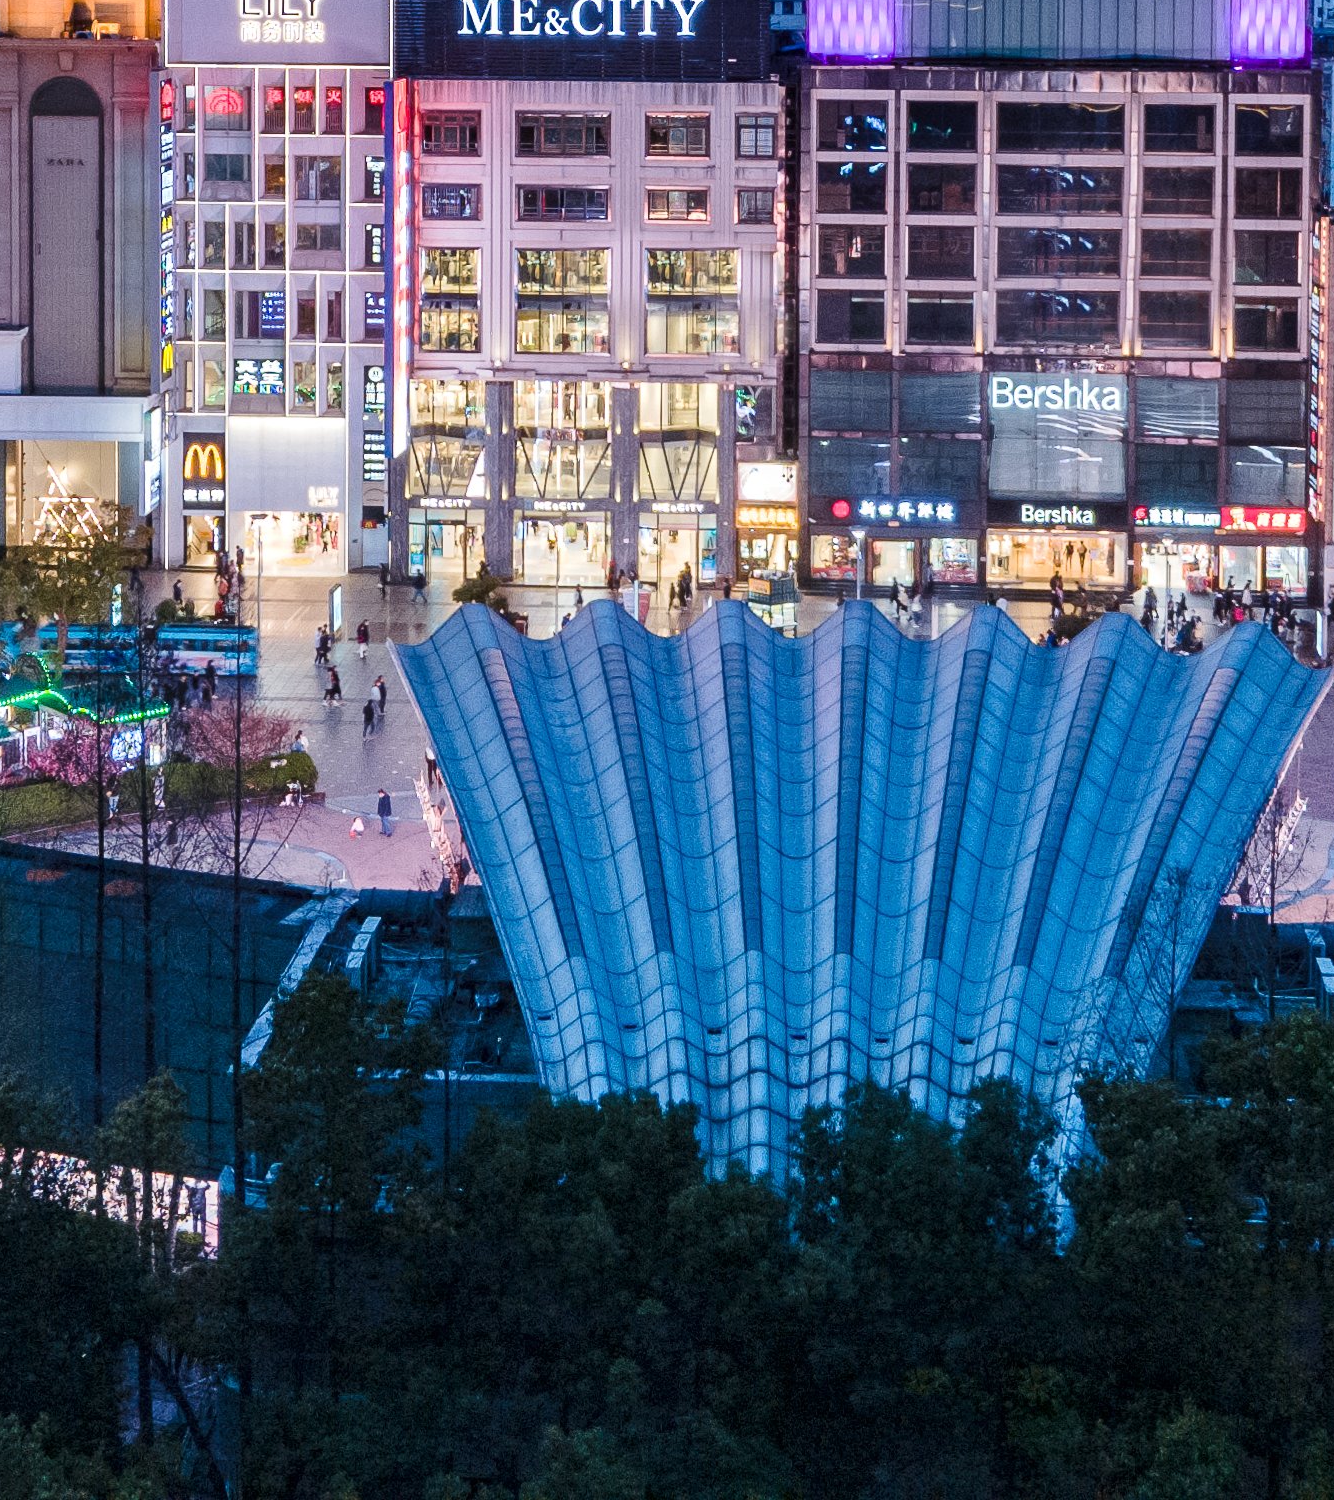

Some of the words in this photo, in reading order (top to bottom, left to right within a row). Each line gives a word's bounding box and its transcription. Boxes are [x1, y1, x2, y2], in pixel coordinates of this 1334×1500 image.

[240, 20, 325, 43] 商务时装
[46, 157, 85, 167] ZARA
[233, 383, 258, 394] SILK
[259, 383, 284, 394] KING
[990, 376, 1122, 411] Bershka
[1021, 503, 1095, 525] Bershka
